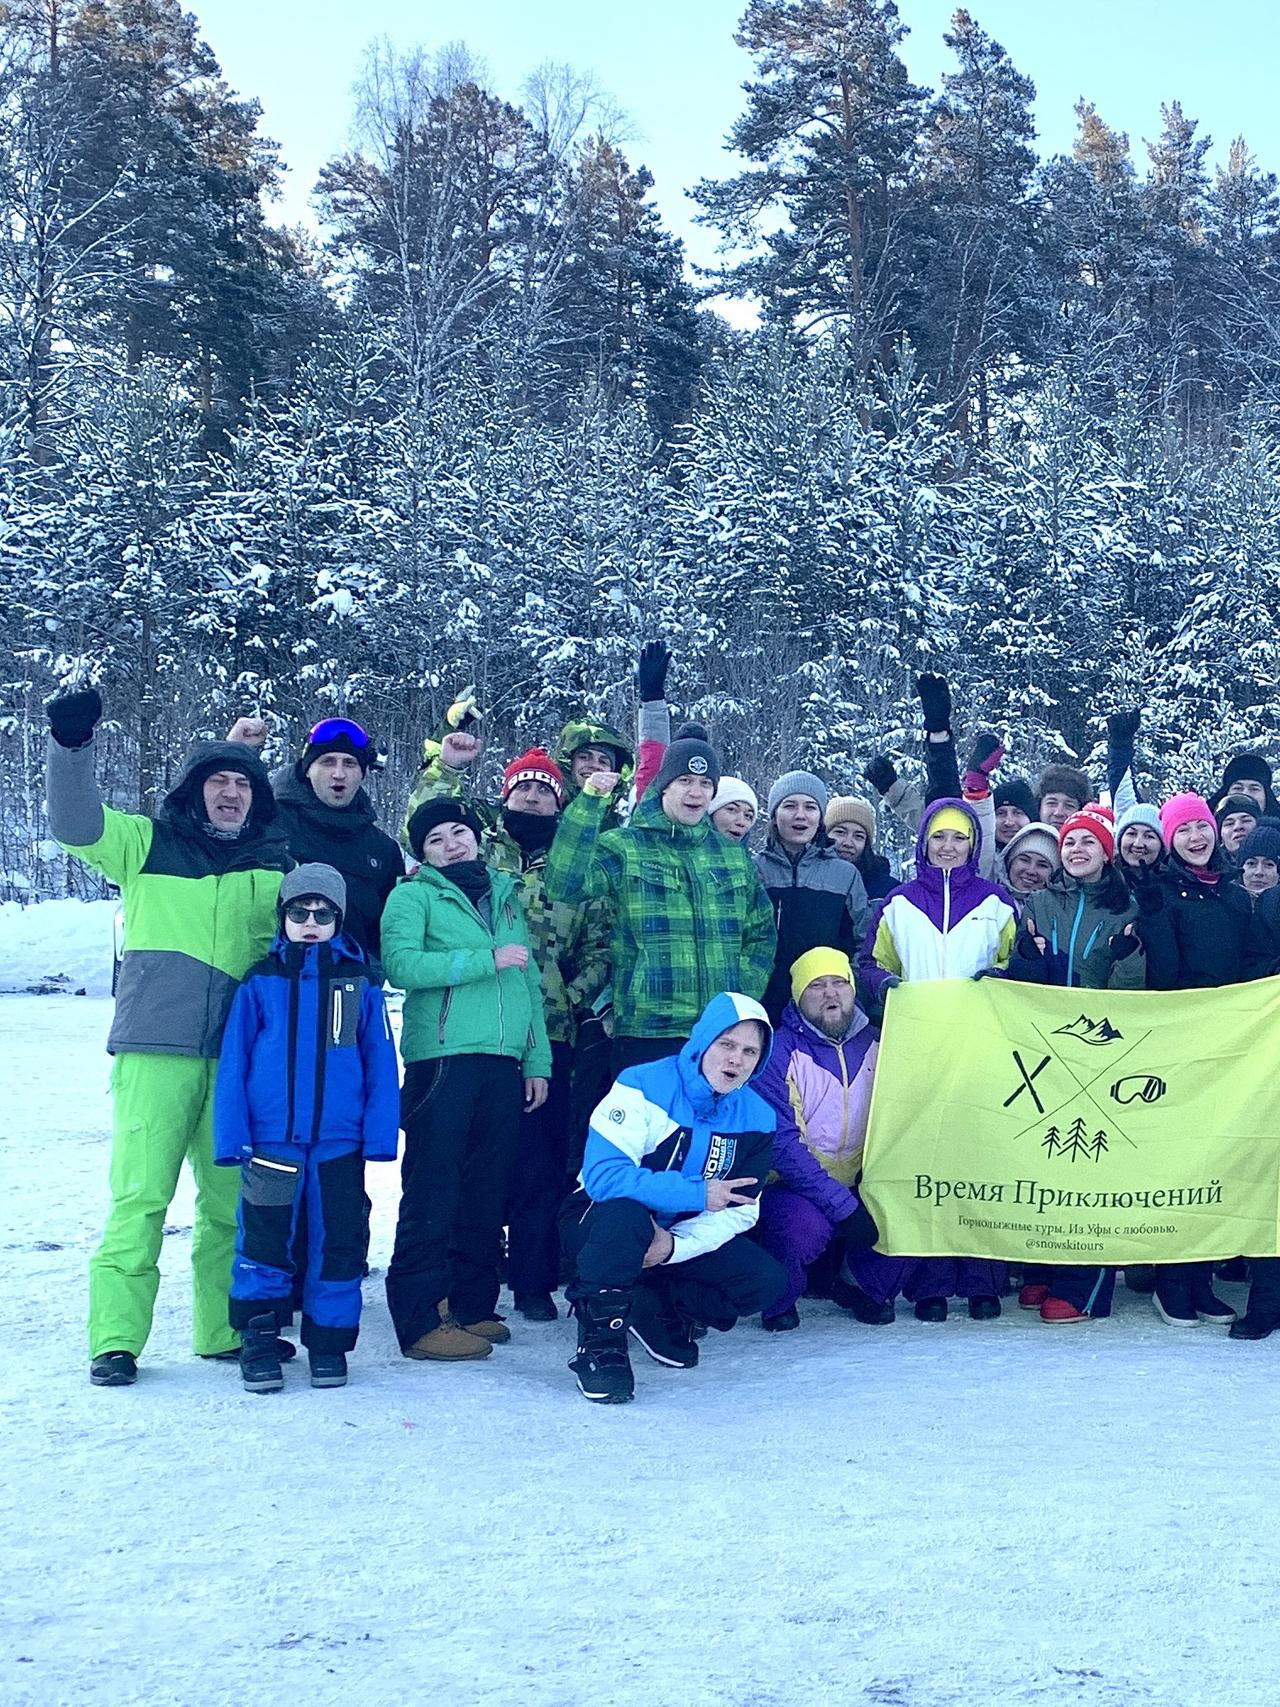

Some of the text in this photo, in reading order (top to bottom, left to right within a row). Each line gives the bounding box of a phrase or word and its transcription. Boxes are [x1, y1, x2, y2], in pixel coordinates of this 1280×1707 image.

[507, 770, 562, 798] SOCHI
[914, 1174, 1223, 1214] Время Приключений
[958, 1215, 1179, 1237] Горнолыжные туры. Из Уфы с любовью.
[1025, 1238, 1105, 1251] @snowskitours
